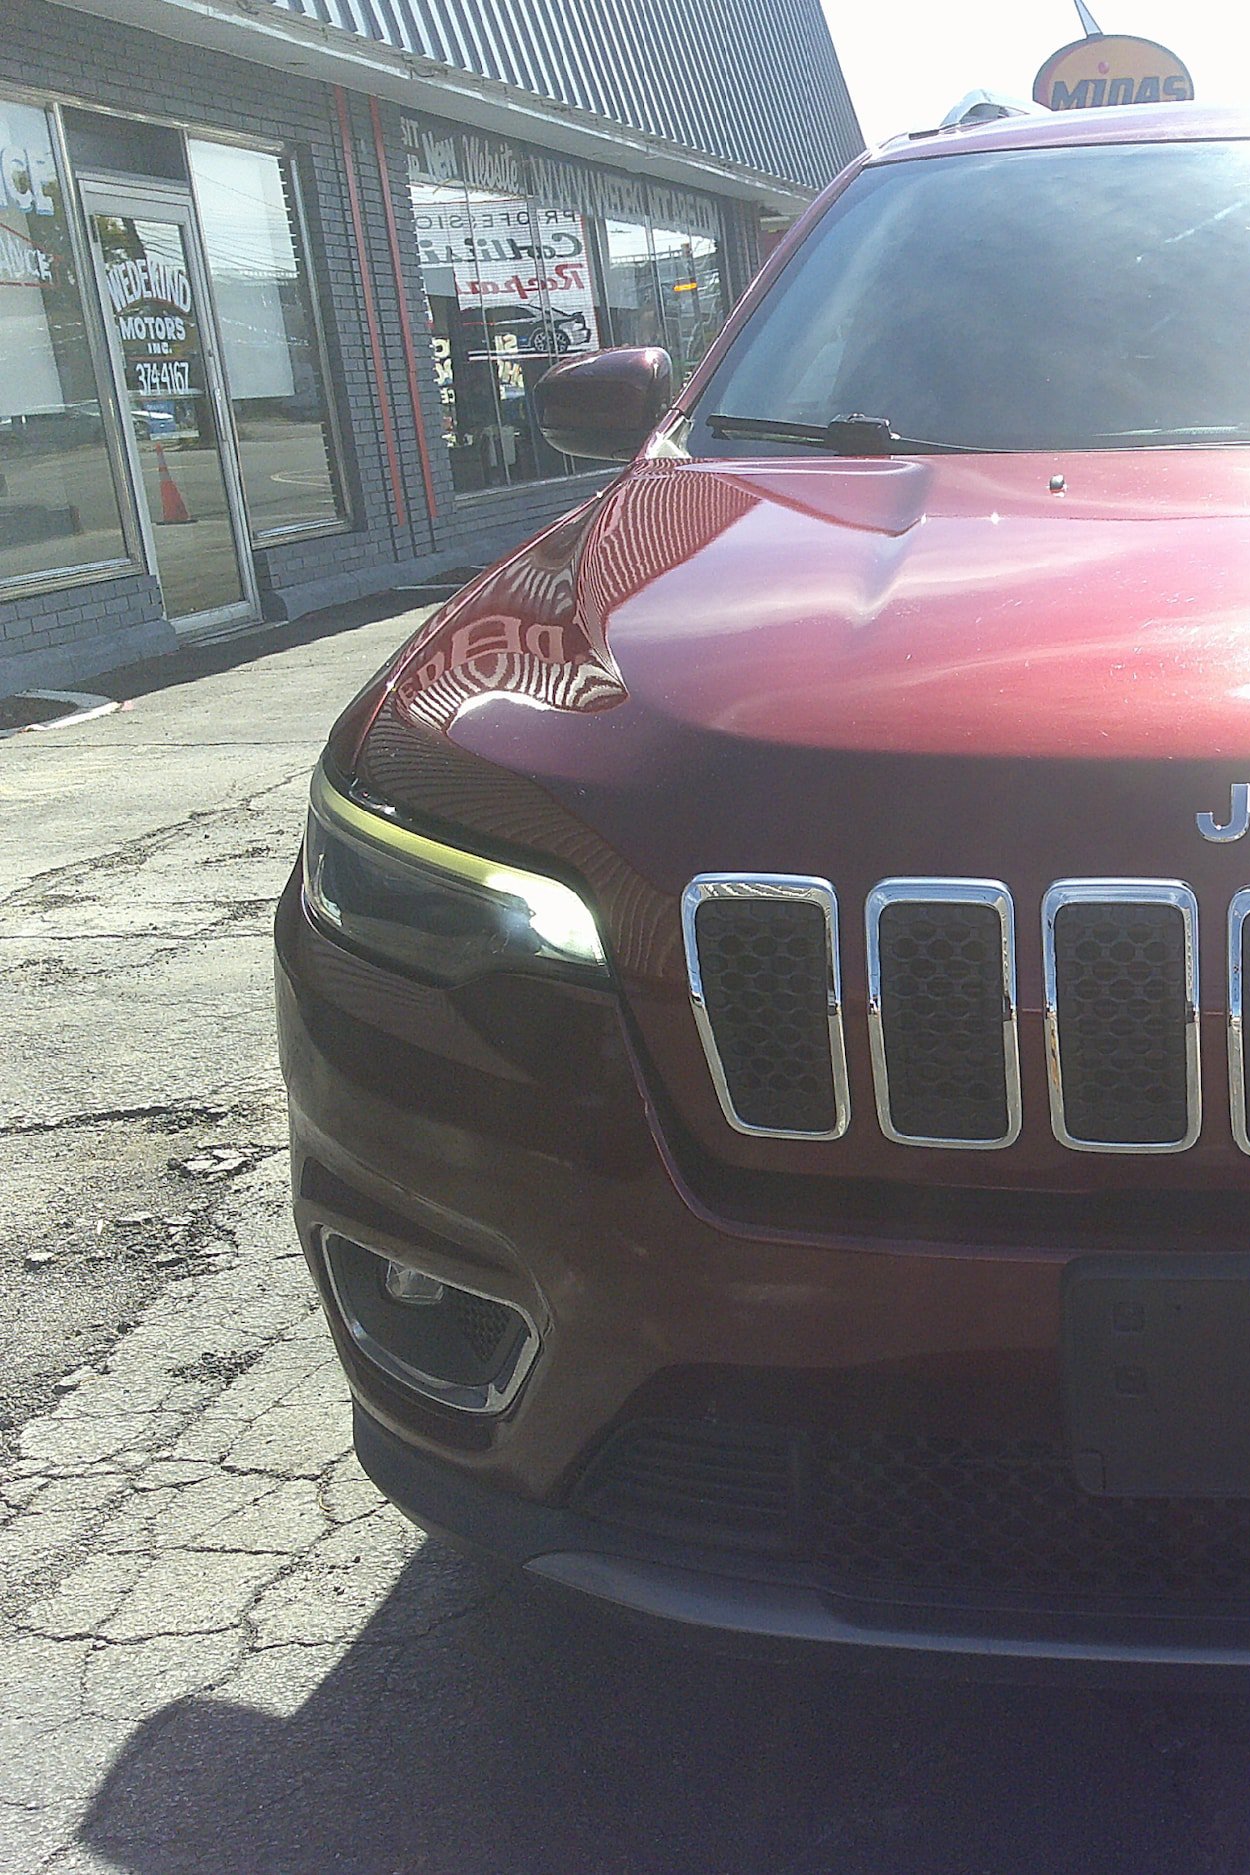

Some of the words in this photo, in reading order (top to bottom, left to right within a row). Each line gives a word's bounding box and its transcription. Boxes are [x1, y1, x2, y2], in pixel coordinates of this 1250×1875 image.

[1051, 75, 1188, 110] MIDAS
[106, 258, 192, 313] WEDEKIND
[119, 316, 186, 341] MOTORS
[147, 342, 173, 354] INC.
[136, 360, 190, 396] 374-4167
